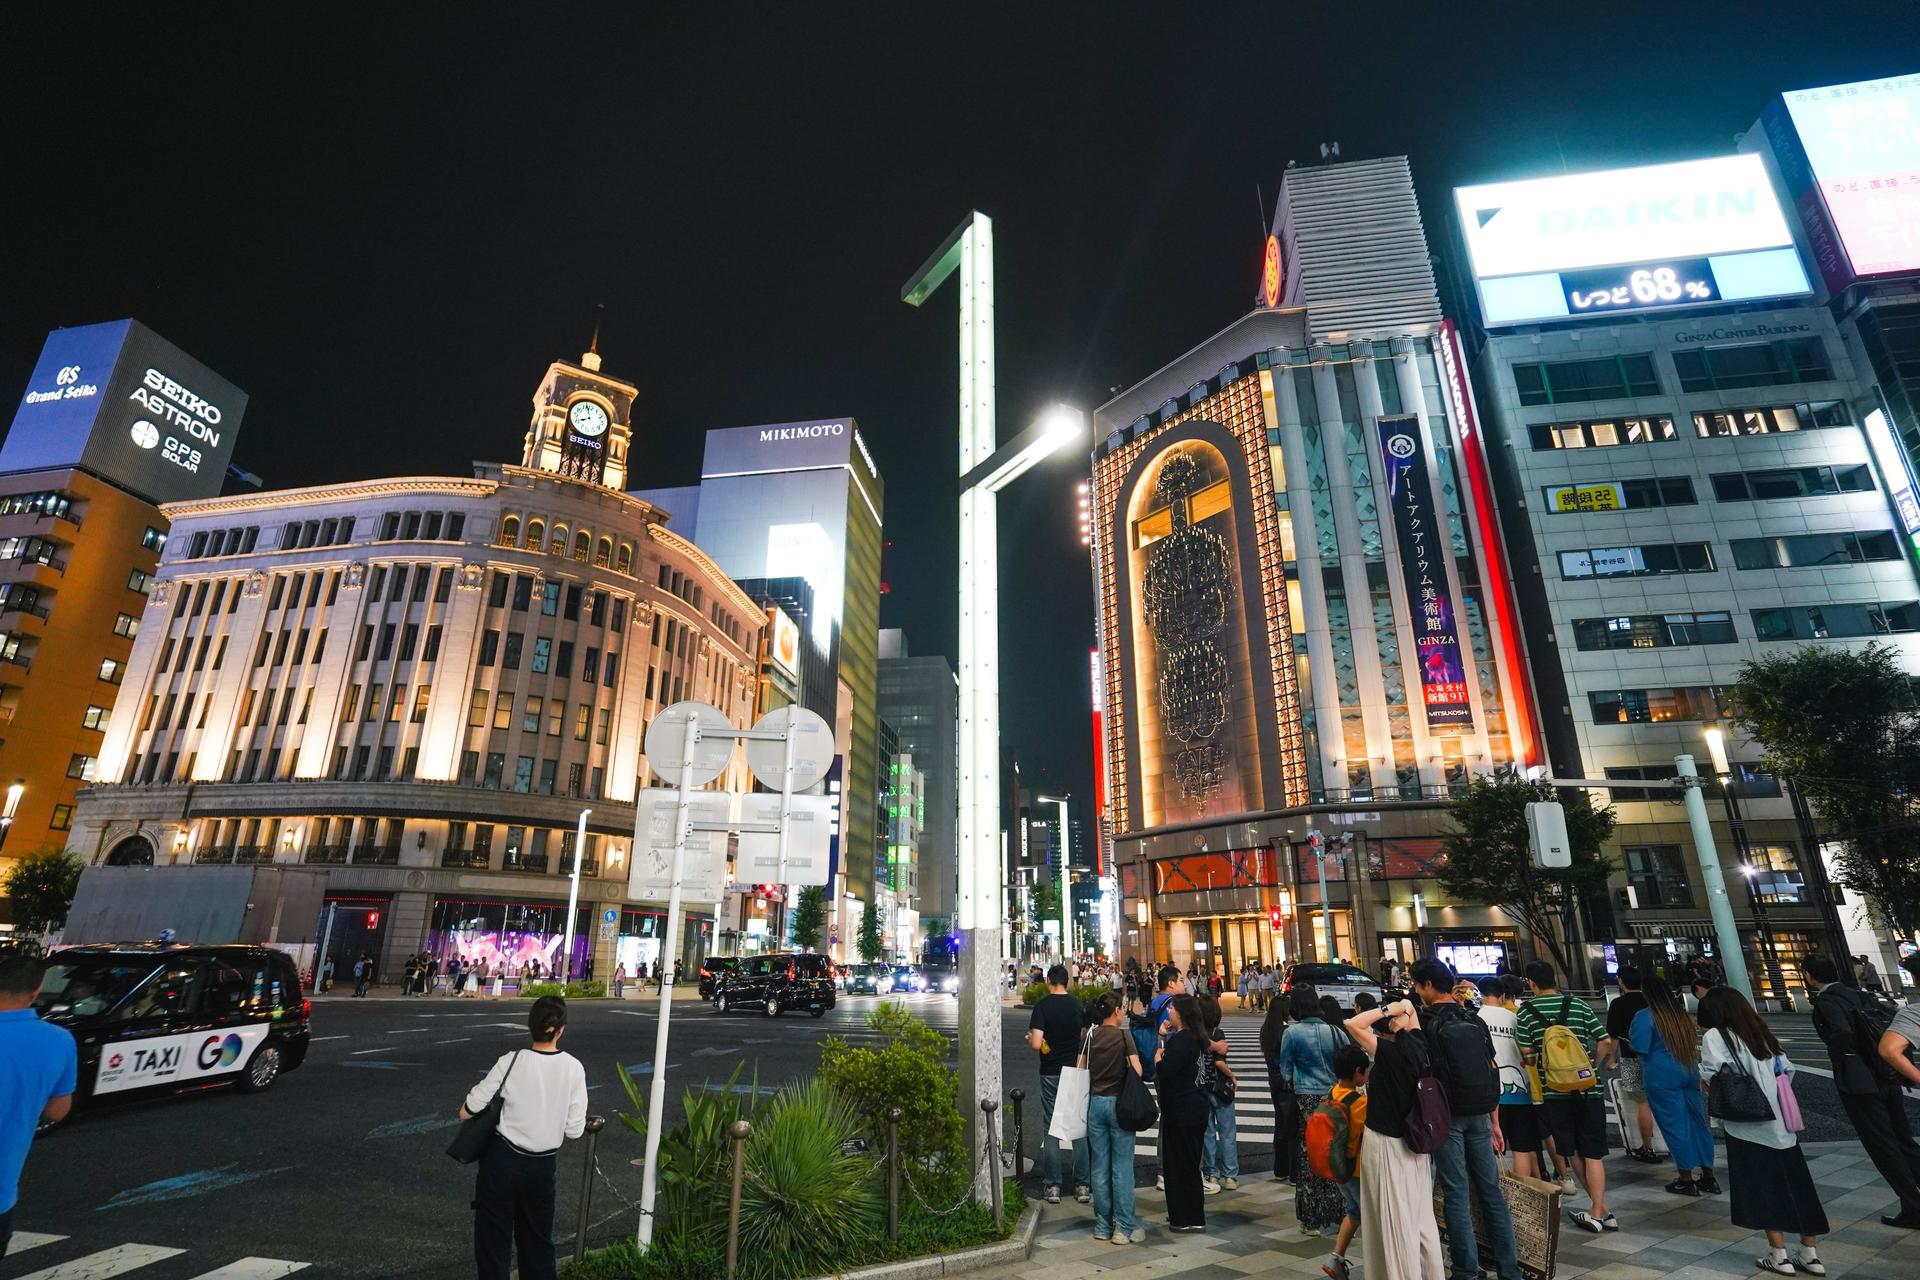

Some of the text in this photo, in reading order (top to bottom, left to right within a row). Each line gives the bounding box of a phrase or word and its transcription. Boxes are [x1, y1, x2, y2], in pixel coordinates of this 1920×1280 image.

[1537, 187, 1756, 237] DAIKIN
[1572, 267, 1711, 308] しつど 68 %
[1675, 324, 1810, 343] GINZA CENTER BUILDING
[56, 366, 81, 386] GS
[26, 384, 98, 404] Grand Seiko
[143, 368, 222, 425] SEIKO
[129, 387, 220, 448] ASTRON
[569, 434, 602, 449] SEIKO
[760, 424, 844, 441] MIKIMOTO
[161, 449, 198, 474] SOLAR
[164, 436, 202, 465] GPS
[1400, 465, 1442, 631] アートアクアリウム美術館
[1417, 635, 1456, 646] GINZA
[1427, 684, 1463, 693] 入場受付
[1427, 691, 1465, 703] 新館9F
[1428, 709, 1468, 717] MITSUKOSHI
[134, 1045, 182, 1072] TAXI
[197, 1033, 243, 1071] GO
